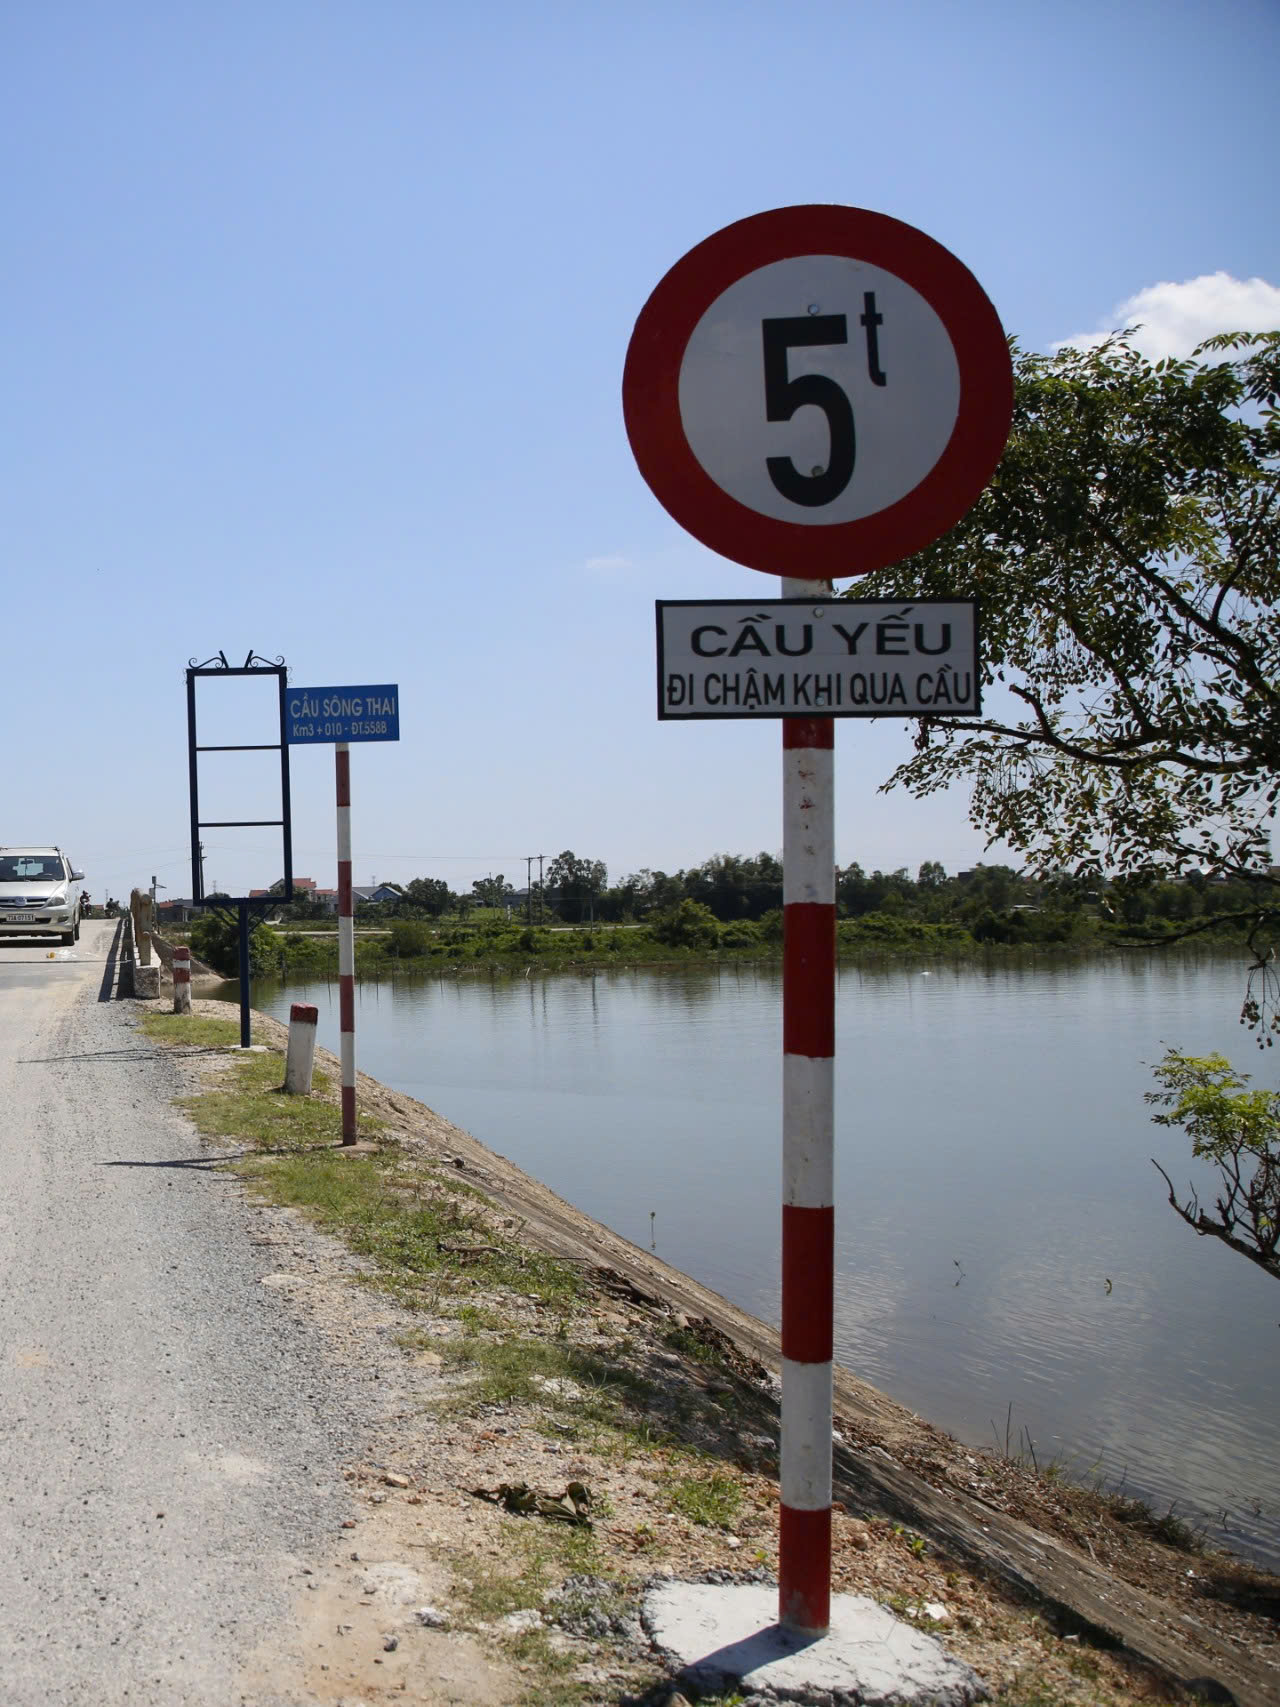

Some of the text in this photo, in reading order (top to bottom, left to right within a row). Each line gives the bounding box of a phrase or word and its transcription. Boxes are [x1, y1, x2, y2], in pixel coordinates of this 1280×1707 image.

[691, 608, 951, 657] CẦU YẾU
[666, 663, 971, 710] ĐI CHẬM KHI QUA CẦU
[290, 693, 395, 718] CẦU SÔNG THAI
[293, 723, 314, 736] Km3
[324, 722, 342, 735] 010
